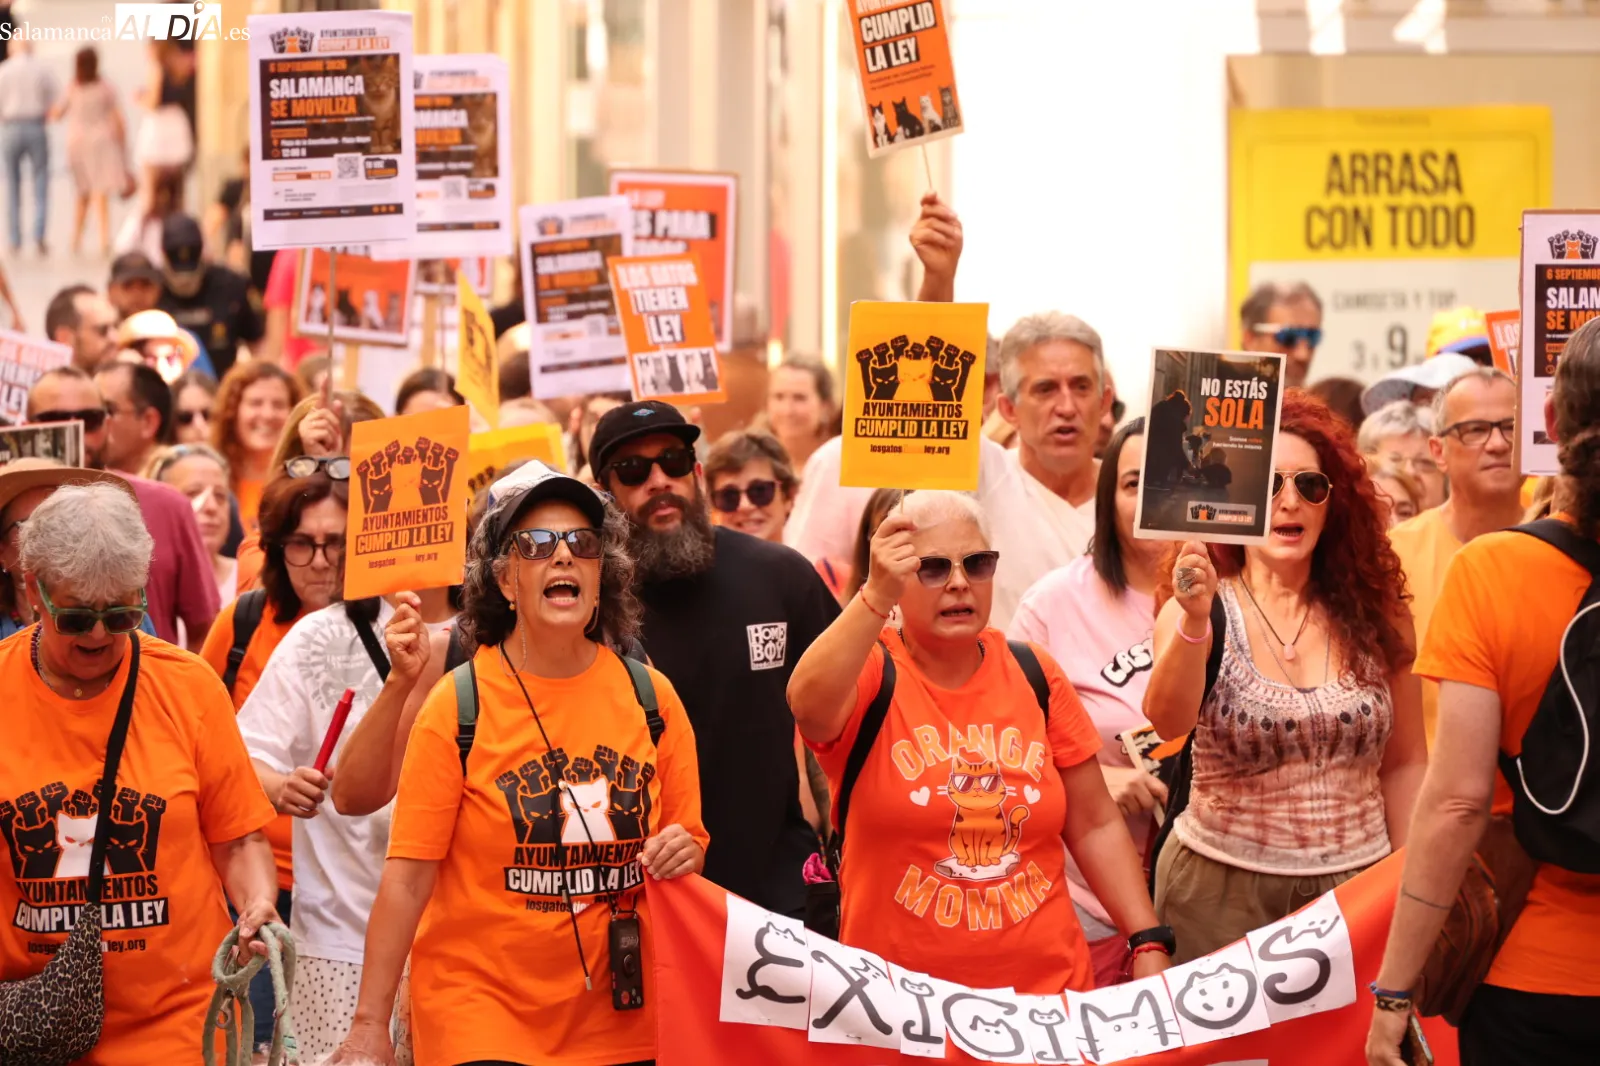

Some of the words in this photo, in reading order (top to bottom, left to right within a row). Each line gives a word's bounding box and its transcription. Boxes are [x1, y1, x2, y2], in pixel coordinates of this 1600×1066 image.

[860, 1, 936, 43] CUMPLID
[865, 44, 888, 73] LA
[888, 36, 917, 67] LEY
[269, 75, 364, 99] SALAMANCA
[271, 99, 288, 118] SE
[291, 96, 357, 118] MOVILIZA
[1325, 151, 1463, 196] ARRASA
[1305, 205, 1372, 250] CON
[1386, 204, 1475, 250] TODO
[615, 263, 650, 289] LOS
[650, 261, 699, 287] GATOS
[1546, 268, 1553, 280] 6
[633, 287, 690, 313] TIENEN
[1332, 290, 1407, 311] CAMISETA
[1413, 290, 1421, 308] Y
[1427, 289, 1457, 309] TOP
[648, 314, 684, 344] LEY
[1547, 310, 1565, 330] SE
[1387, 323, 1408, 369] 9
[1200, 377, 1220, 396] NO
[1224, 376, 1268, 400] ESTÁS
[862, 402, 963, 418] AYUNTAMIENTOS
[1204, 396, 1264, 430] SOLA
[857, 419, 918, 437] CUMPLID
[921, 420, 938, 437] LA
[942, 421, 966, 438] LEY
[362, 505, 449, 533] AYUNTAMIENTOS
[357, 529, 410, 554] CUMPLID
[413, 527, 428, 549] LA
[431, 524, 452, 543] LEY
[749, 625, 785, 644] HOME
[890, 721, 1046, 783] ORANGE
[508, 868, 595, 894] CUMPLID
[599, 867, 619, 891] LA
[623, 860, 643, 887] LEY
[893, 860, 1053, 932] MOMMA
[16, 901, 86, 932] CUMPLI
[101, 903, 125, 929] LA
[131, 899, 166, 927] LEY
[736, 914, 1340, 1062] EXIGIMOS
